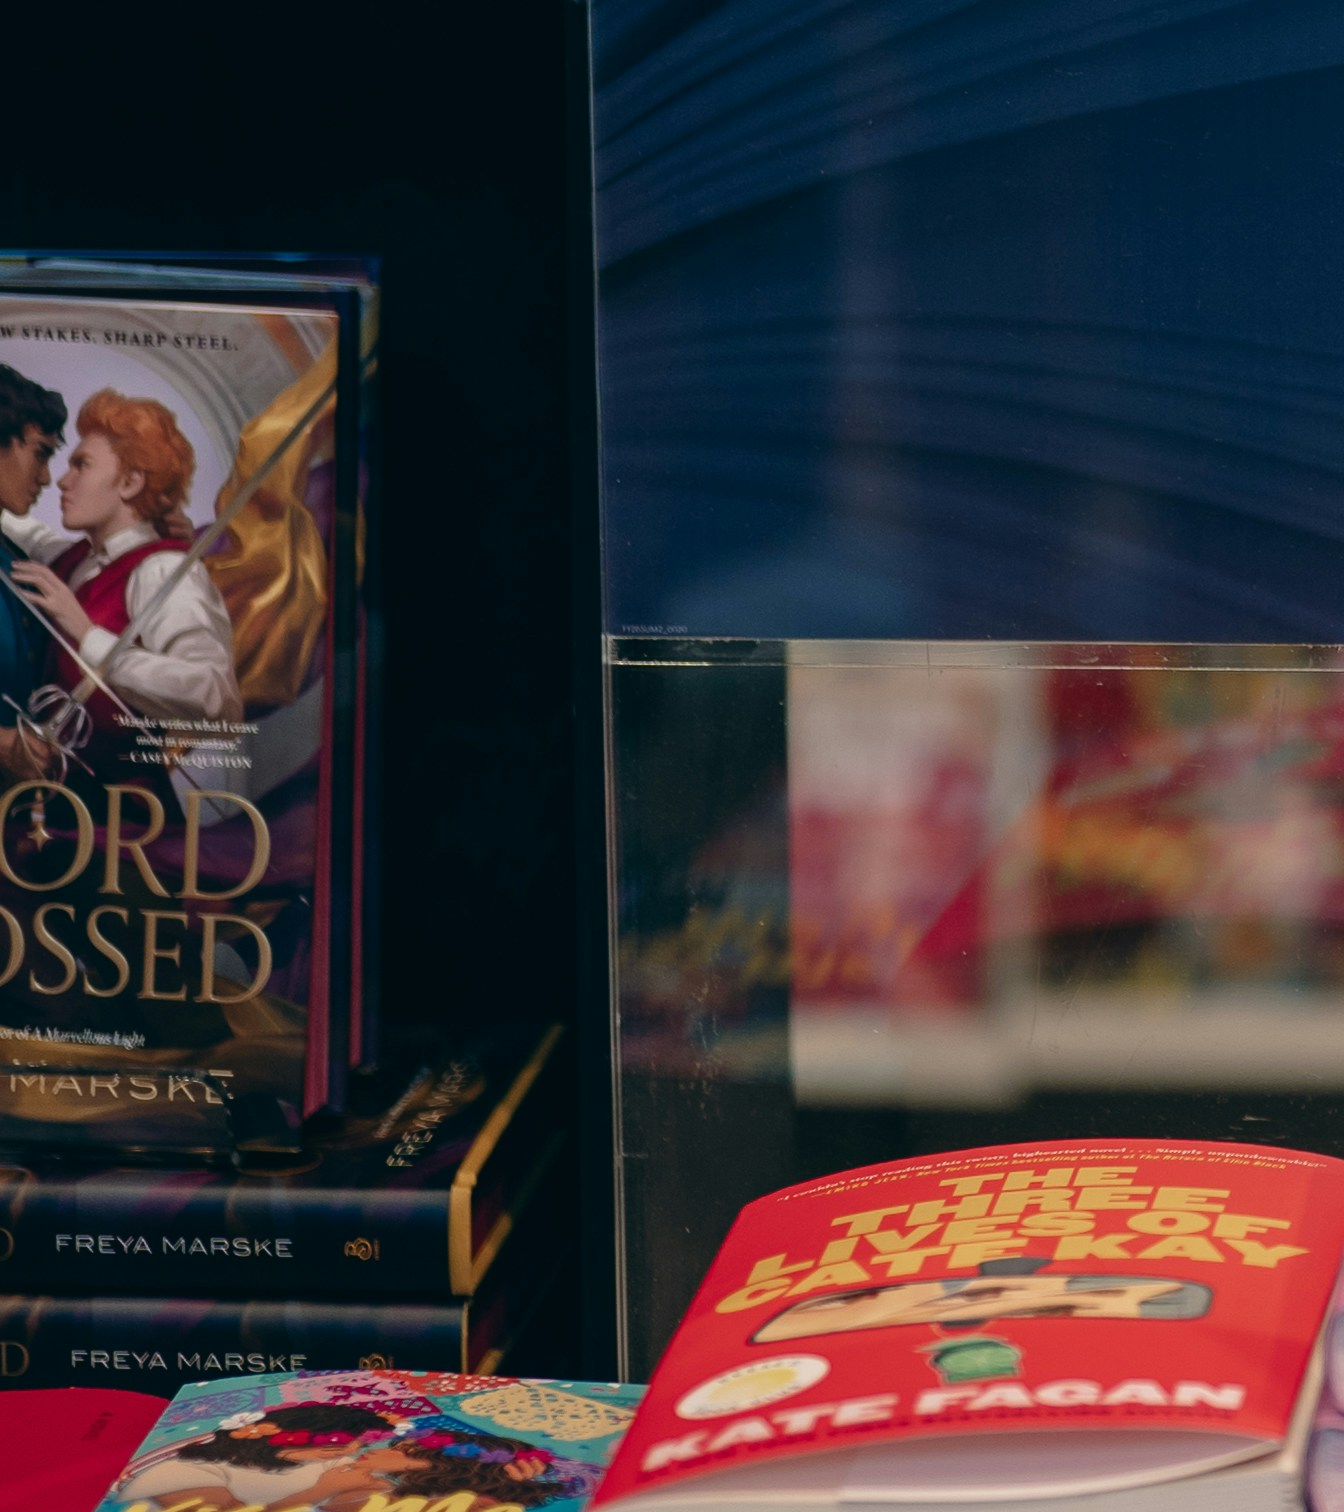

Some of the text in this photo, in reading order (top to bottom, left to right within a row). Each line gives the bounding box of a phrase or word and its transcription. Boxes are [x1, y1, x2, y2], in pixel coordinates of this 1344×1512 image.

[937, 1165, 1139, 1194] THE
[831, 1186, 1231, 1236] THREE
[55, 1234, 293, 1258] FREYA MARSKE
[745, 1209, 1292, 1286] LIVES OF
[714, 1233, 1310, 1314] CATE KAY
[71, 1349, 168, 1371] FREYA
[641, 1379, 1247, 1473] KATE FAGAN
